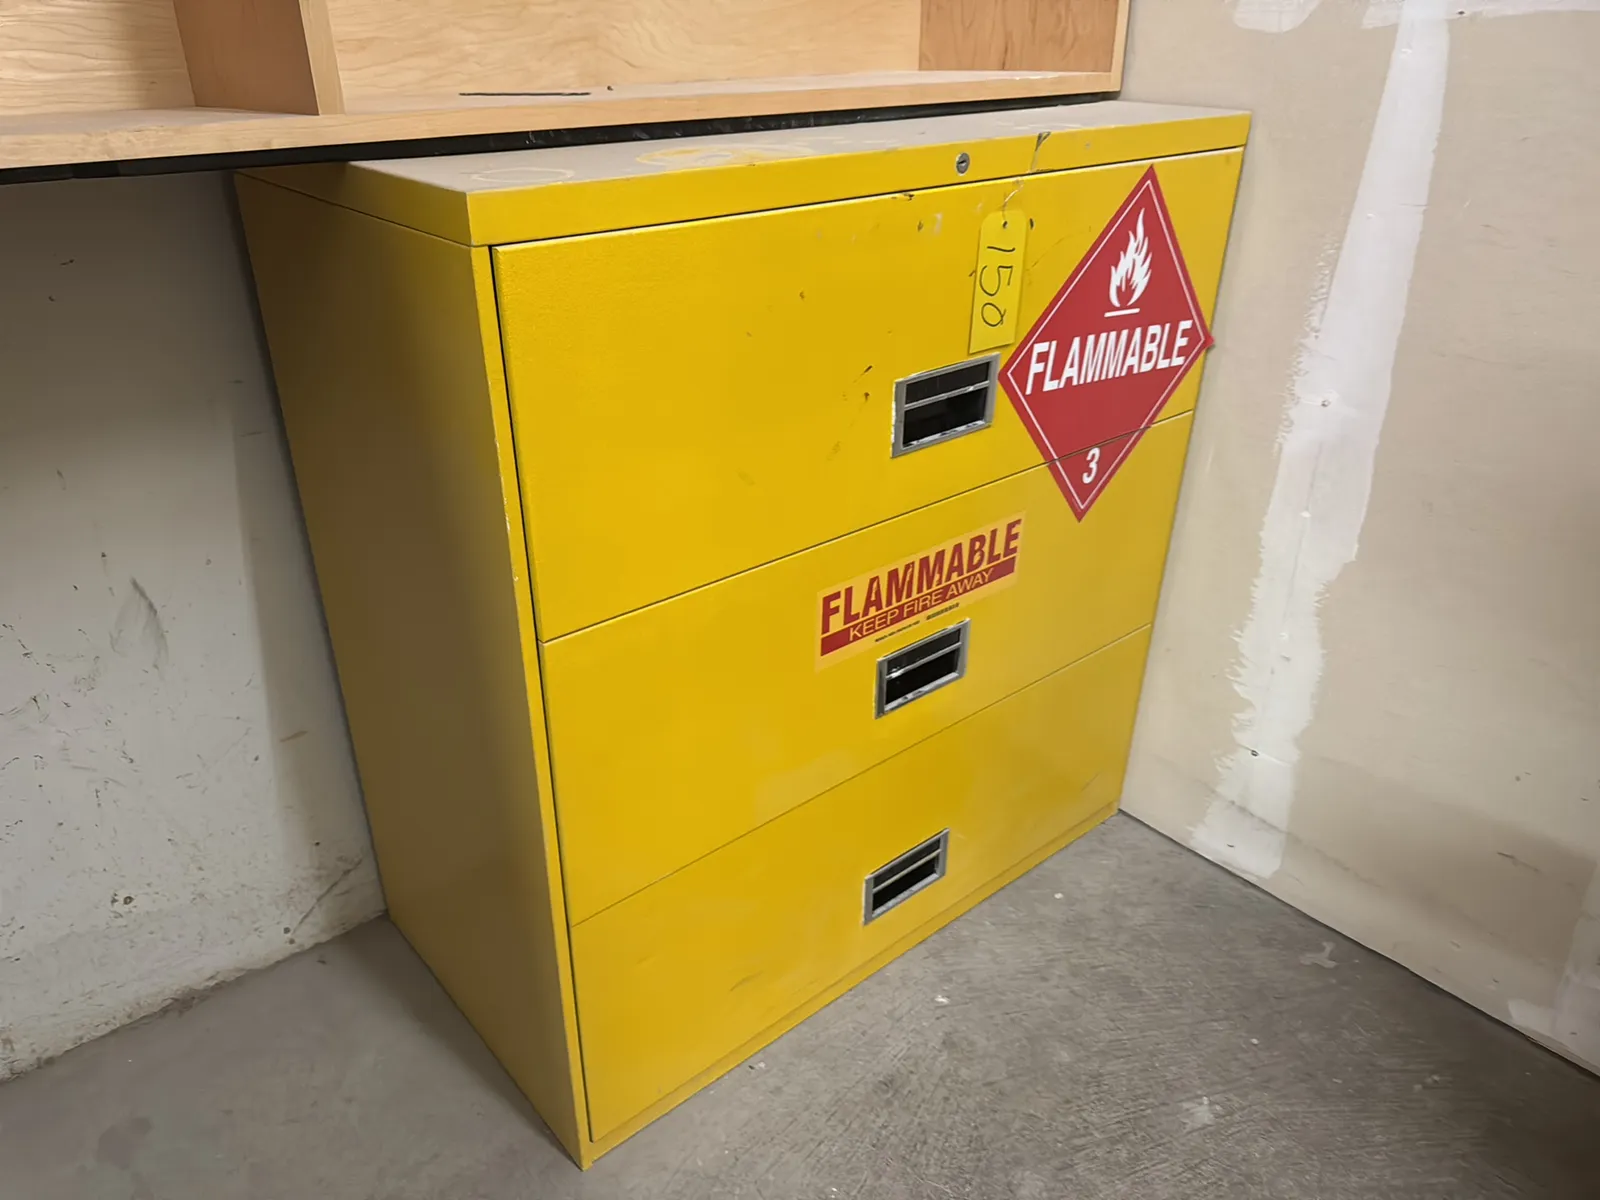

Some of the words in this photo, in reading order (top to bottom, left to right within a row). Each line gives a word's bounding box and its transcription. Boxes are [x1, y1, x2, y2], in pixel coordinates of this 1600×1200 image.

[979, 246, 1016, 327] 150
[1025, 320, 1193, 395] FLAMMABLE
[1082, 447, 1101, 484] 3
[821, 518, 1022, 635] FLAMMABLE
[849, 608, 899, 641] KEEP
[903, 588, 944, 617] FIRE
[945, 567, 994, 599] AWAY
